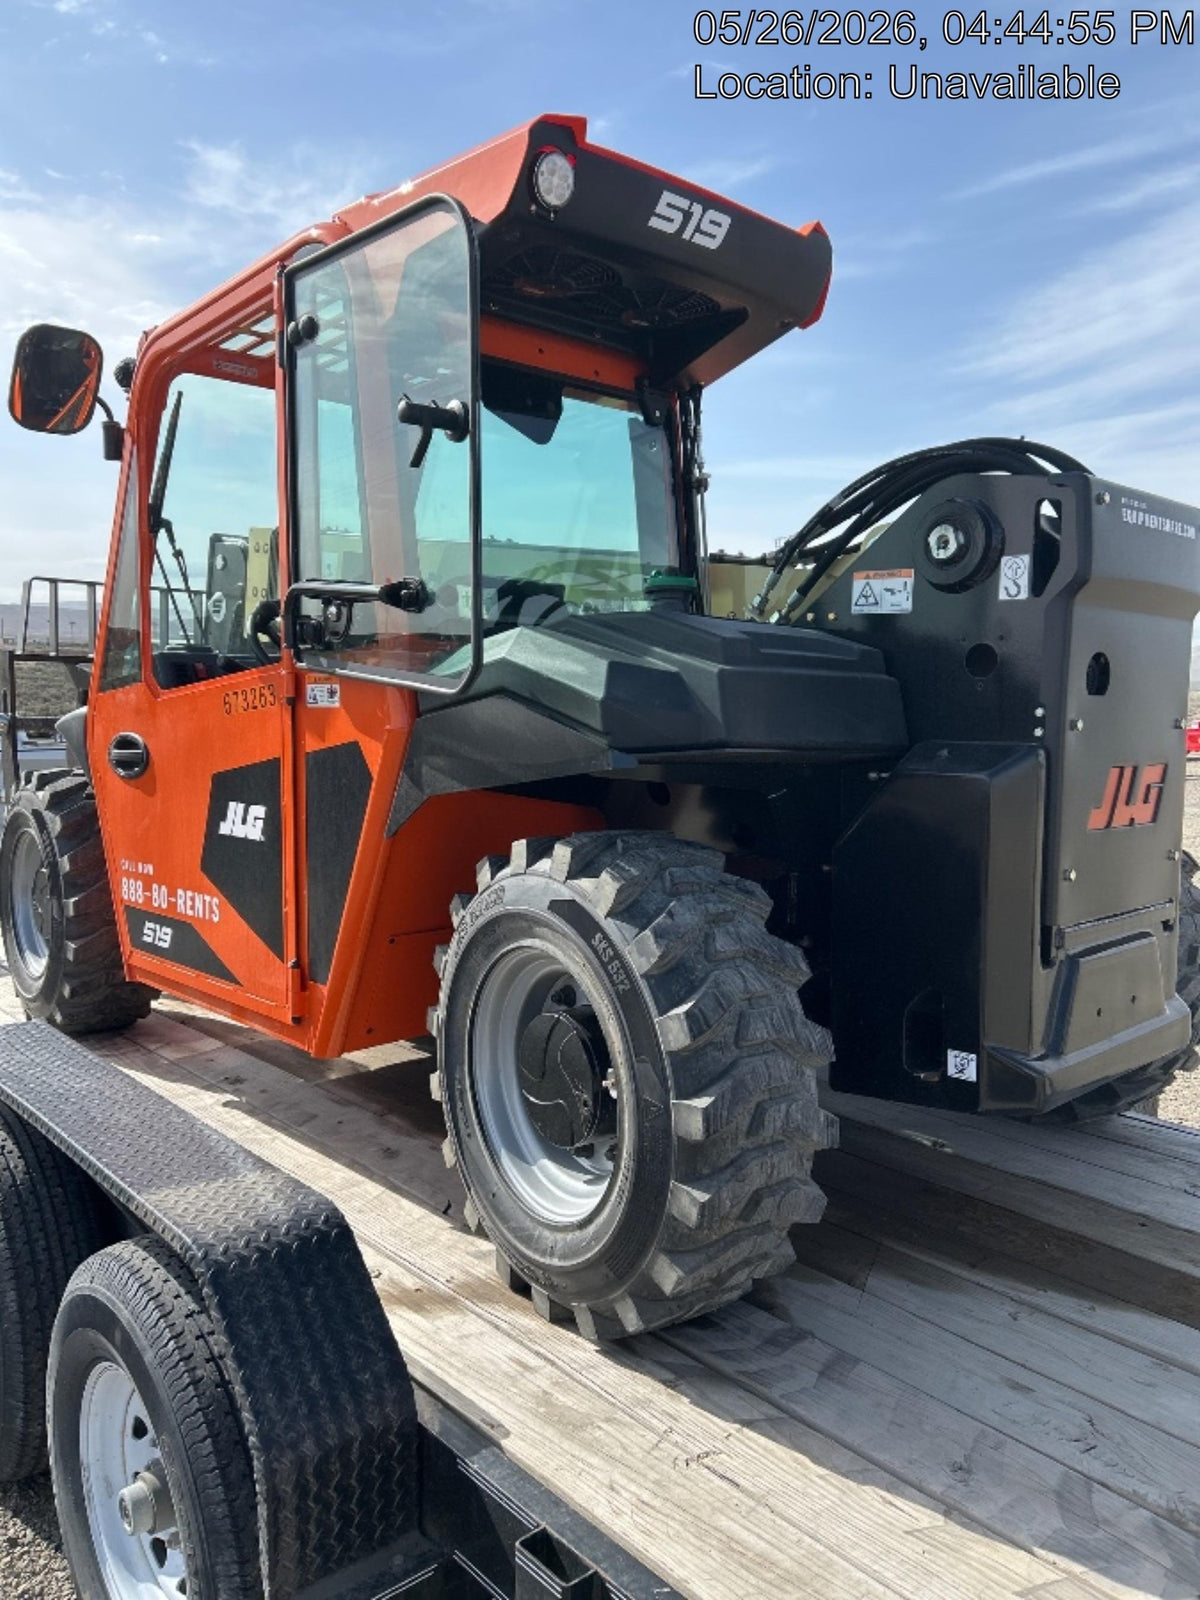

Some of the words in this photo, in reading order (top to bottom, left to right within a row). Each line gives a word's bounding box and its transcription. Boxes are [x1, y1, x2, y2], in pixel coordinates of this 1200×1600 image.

[648, 190, 732, 250] 519
[223, 683, 276, 716] 673263
[1087, 762, 1167, 831] JLG
[218, 801, 267, 841] JLG
[121, 876, 220, 923] 888-80-RENTS
[142, 920, 173, 949] 519
[591, 932, 614, 963] SKS
